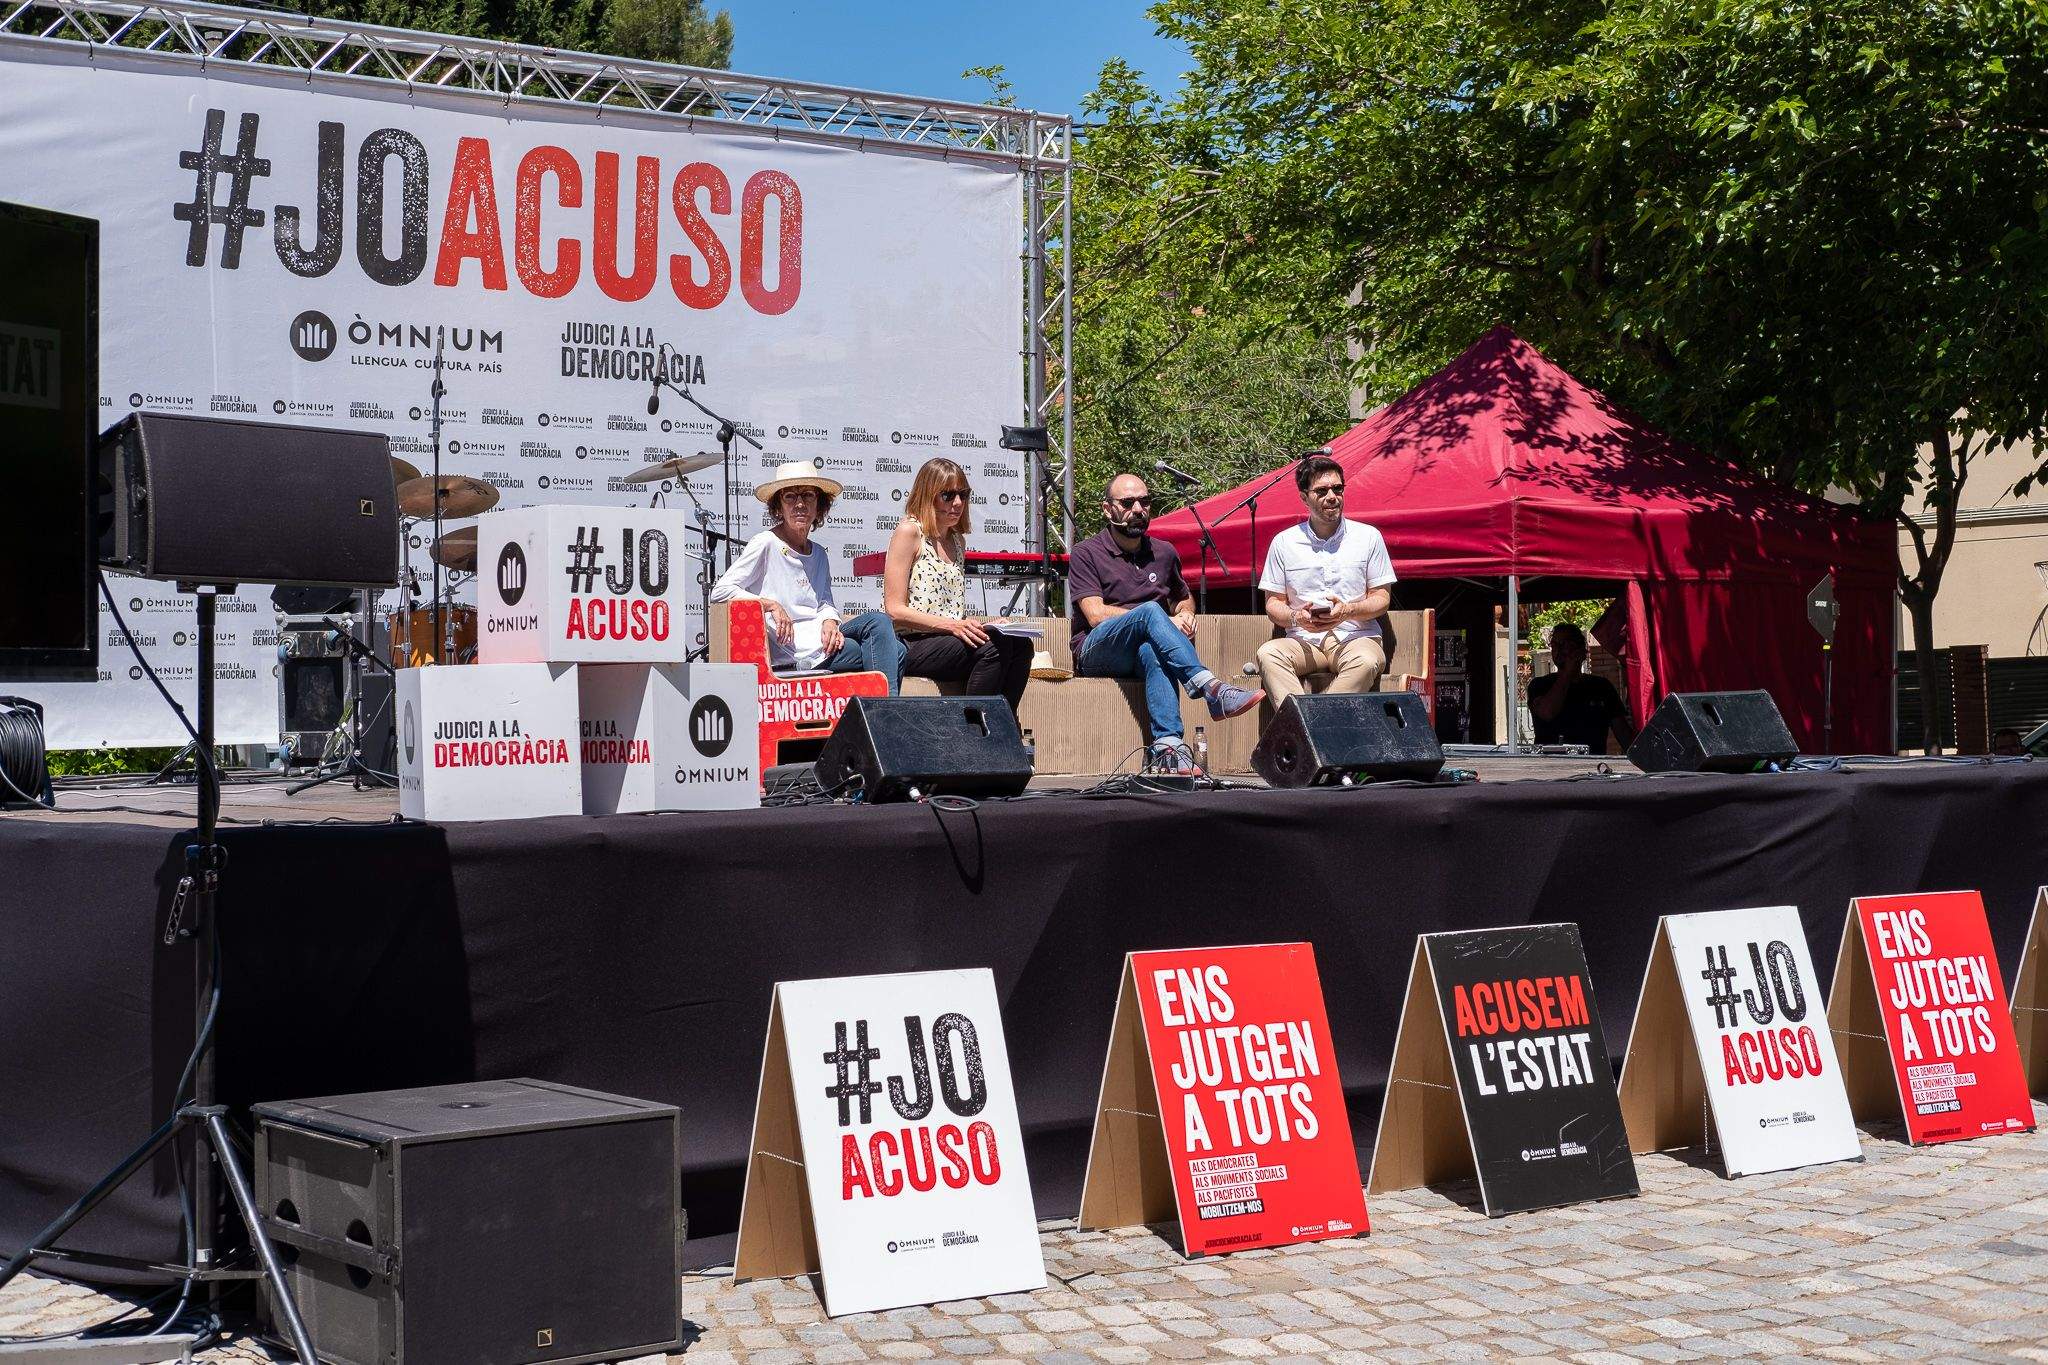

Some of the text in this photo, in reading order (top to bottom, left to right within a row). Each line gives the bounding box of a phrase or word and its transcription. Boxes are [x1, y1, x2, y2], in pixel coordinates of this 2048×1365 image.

[173, 108, 803, 316] #JOACUSO
[348, 313, 502, 353] ÒMNIUM
[561, 321, 655, 349] JUDICI A LA
[351, 355, 408, 368] LLENGUA
[478, 360, 502, 373] PAÍS
[146, 393, 193, 405] ÒMNIUM
[210, 401, 257, 414] DEMOCRÀCIA
[289, 400, 334, 412] ÒMNIUM
[350, 408, 394, 420] DEMOCRÀCIA
[424, 407, 467, 418] ÒNIUM
[482, 414, 524, 426] DEMOCRÀCIA
[552, 414, 593, 424] ÒMNIUM
[674, 420, 713, 430] ÒMNIUM
[608, 420, 648, 432] DEMOCRÀCIA
[790, 426, 828, 436] ÒMNIUM
[842, 432, 880, 443] DEMOCRÀCIA
[904, 432, 940, 442] ÒMNIUM
[952, 438, 988, 448] DEMOCRÀCIA
[464, 440, 505, 451] ÒMNIUM
[590, 446, 630, 456] ÒMNIUM
[520, 447, 562, 458] DEMOCRÀCIA
[826, 458, 863, 466] ÒMNIUM
[552, 476, 593, 486] ÒMNIUM
[826, 516, 864, 525] ÒMNIUM
[565, 526, 669, 597] #JO
[146, 598, 194, 607] ÒMNIUM
[216, 601, 257, 613] EMOCRÀCIA
[487, 609, 539, 633] ÒMNIUM
[566, 598, 670, 642] ACUSO
[154, 666, 193, 674] MNIUM
[214, 668, 256, 680] EMOCRÀCIA
[758, 681, 823, 699] UDICI A LA
[434, 719, 520, 740] JUDICI A LA
[595, 720, 602, 738] A
[604, 720, 617, 736] LA
[434, 735, 570, 768] DEMOCRÀCIA
[675, 765, 749, 784] ÒMNIUM
[1873, 909, 1933, 959] ENS
[1701, 940, 1807, 1029] #JO
[1889, 955, 1995, 1010] JUTGEN
[1154, 965, 1235, 1027] ENS
[1453, 975, 1590, 1037] ACUSEM
[1900, 1005, 1997, 1061] A TOTS
[1170, 1020, 1321, 1090] JUTGEN
[1721, 1025, 1823, 1087] ACUSO
[823, 1012, 987, 1127] #JO
[1910, 1067, 1920, 1078] ALS
[1912, 1079, 1922, 1090] ALS
[1915, 1092, 1926, 1102] ALS
[1184, 1081, 1320, 1153] A TOTS
[842, 1120, 1001, 1200] ACUSO
[1192, 1160, 1206, 1172] ALS
[1195, 1167, 1285, 1188] ALS MOVIMENTS SOCIALS
[1198, 1186, 1254, 1204] ALS PACIFISTES
[1200, 1200, 1263, 1219] MOBILITZEM-NOS
[900, 1238, 934, 1248] ÒMNIUM
